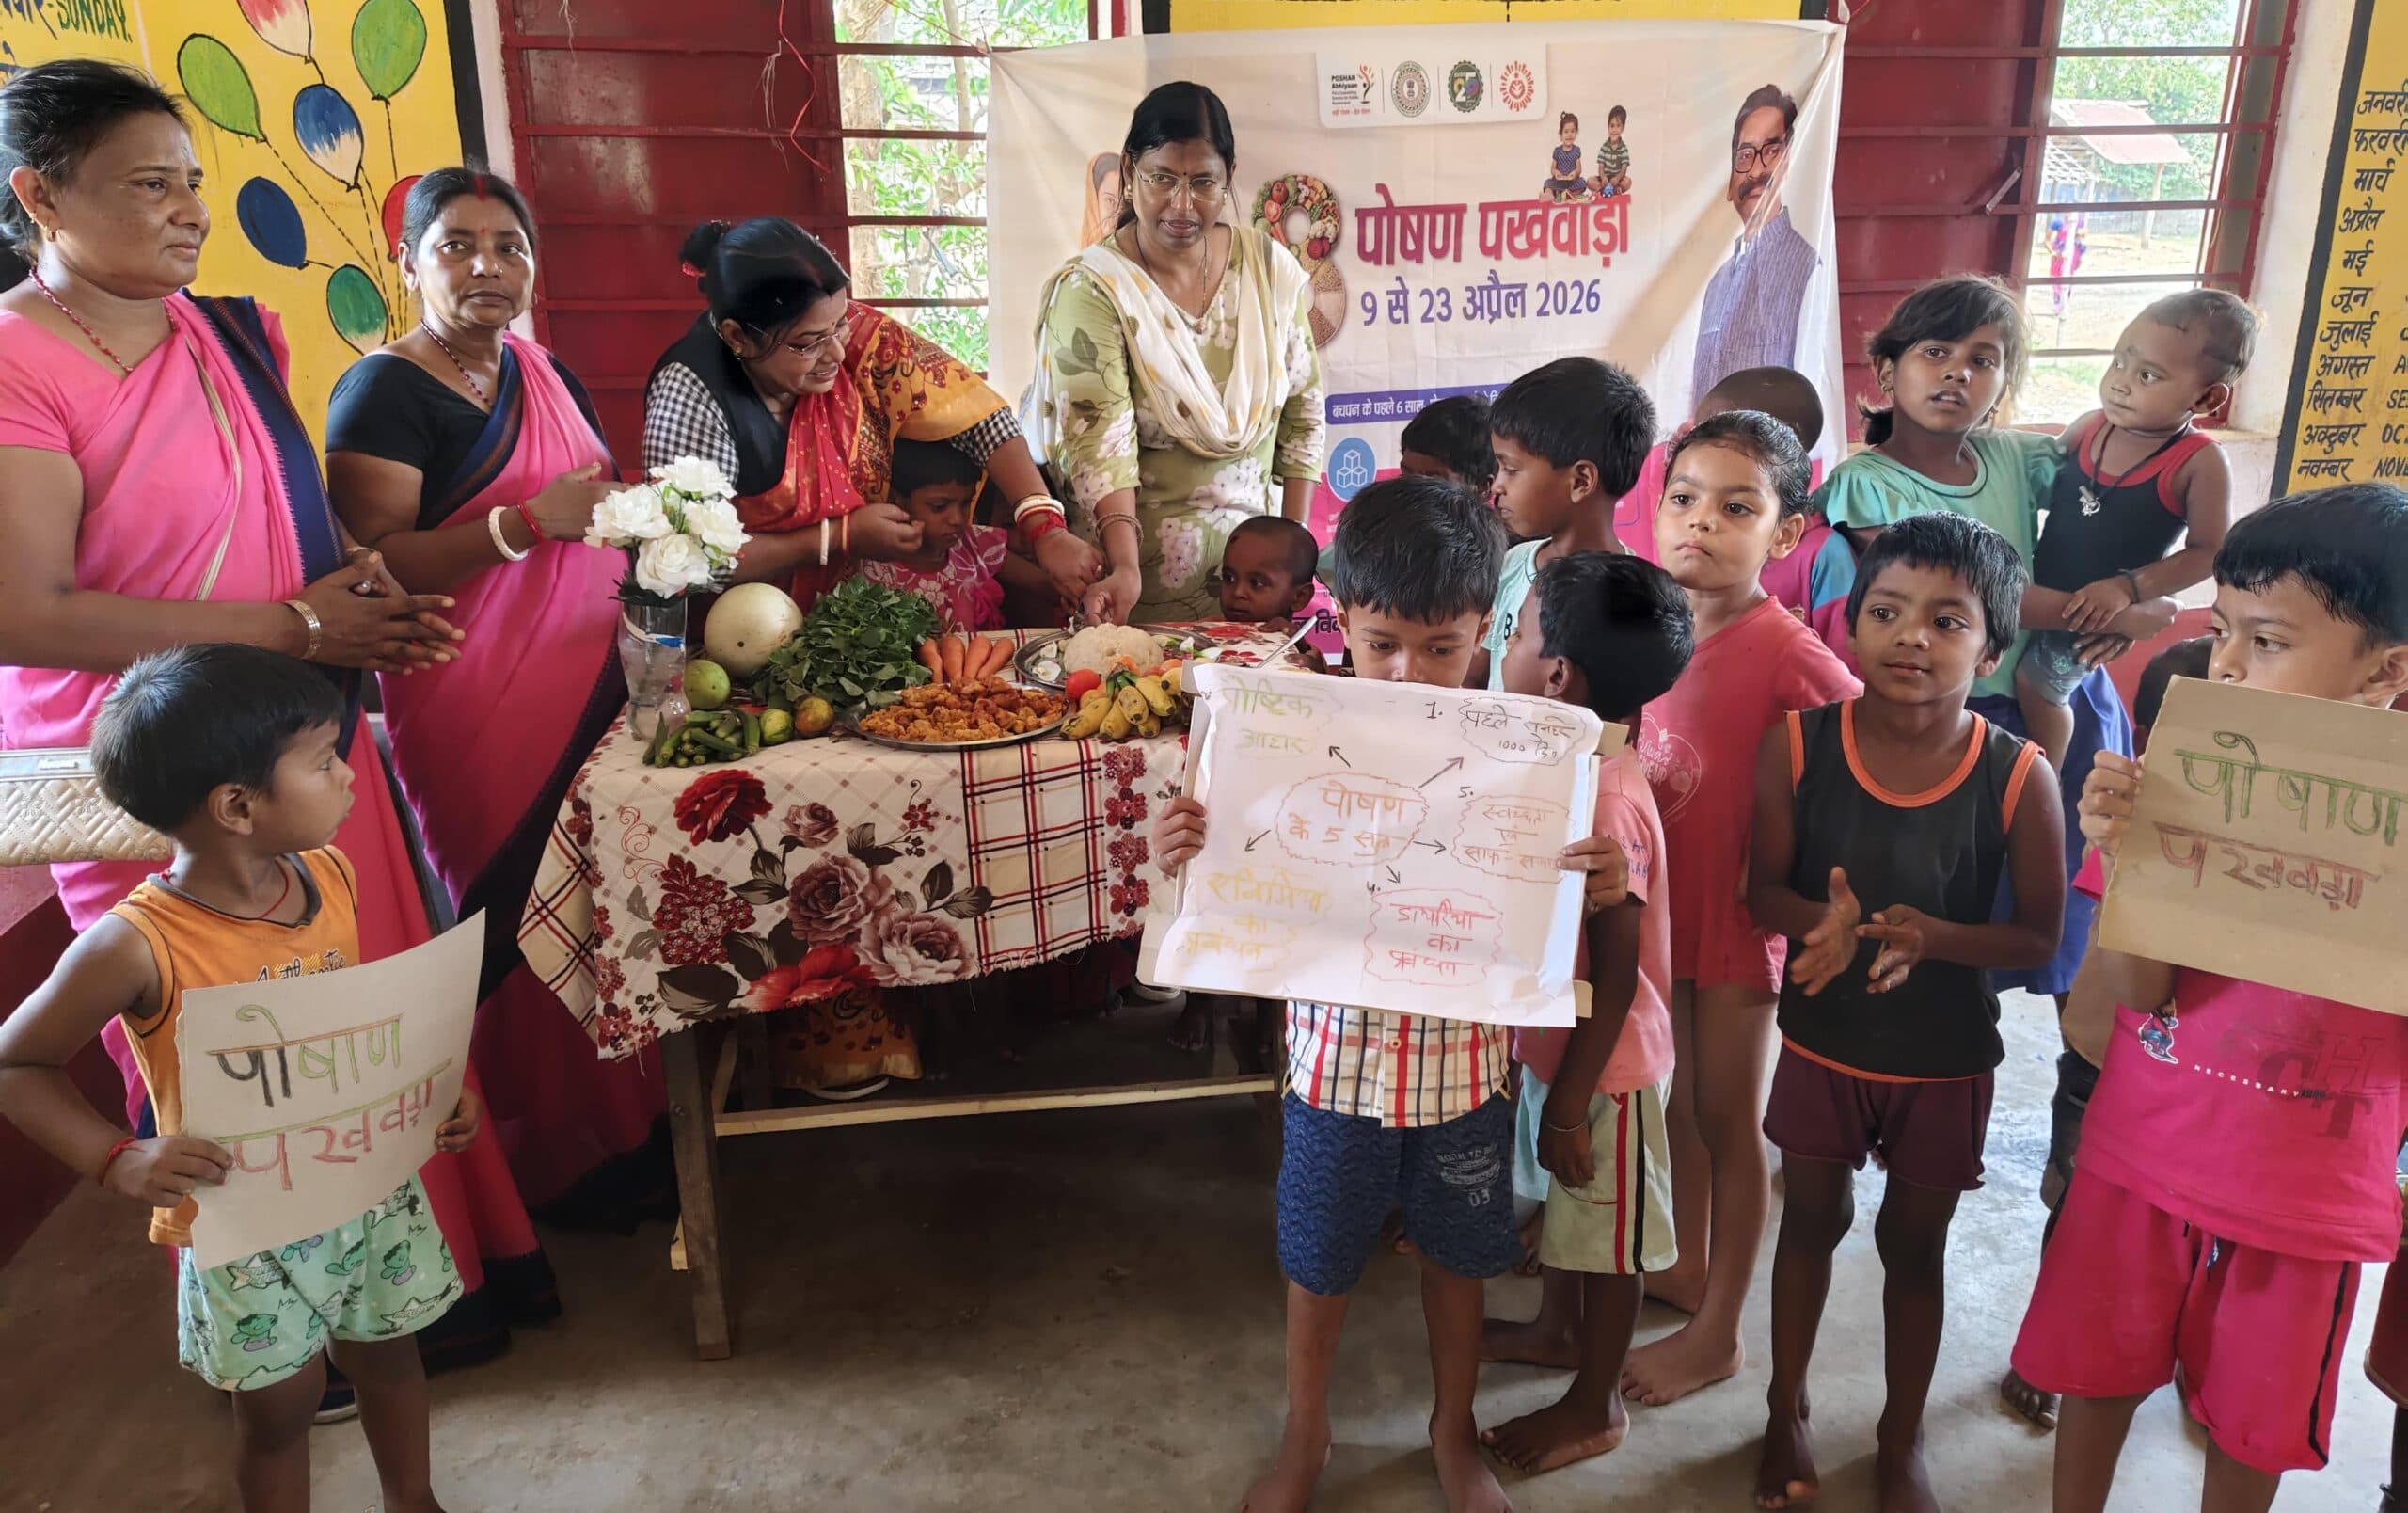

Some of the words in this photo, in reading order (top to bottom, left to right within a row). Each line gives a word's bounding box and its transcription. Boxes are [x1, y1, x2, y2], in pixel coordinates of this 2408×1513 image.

[2353, 158, 2395, 192] मार्च
[1354, 183, 1467, 266] पोषण
[1478, 194, 1631, 267] पखवाड़ा
[2339, 196, 2386, 233] अप्रैल
[2343, 239, 2374, 277] मई
[1361, 291, 1377, 326] 9
[1386, 276, 1409, 325] से
[1419, 286, 1452, 324] 23
[1462, 269, 1528, 324] अप्रैल
[1536, 278, 1601, 318] 2026
[2331, 286, 2373, 313] जून
[2320, 311, 2380, 351] जुलाई
[2316, 355, 2376, 380] अगस्त
[1332, 404, 1360, 418] बचपन
[1362, 398, 1372, 416] के
[1374, 398, 1394, 415] पहले
[1396, 401, 1402, 414] 6
[2306, 380, 2368, 415] सितम्बर
[2297, 458, 2353, 482] नवम्बर
[1498, 740, 1526, 752] 1000
[1317, 779, 1423, 822] पोषण
[1288, 812, 1311, 839] के
[1322, 827, 1346, 843] 5
[1426, 932, 1474, 953] का
